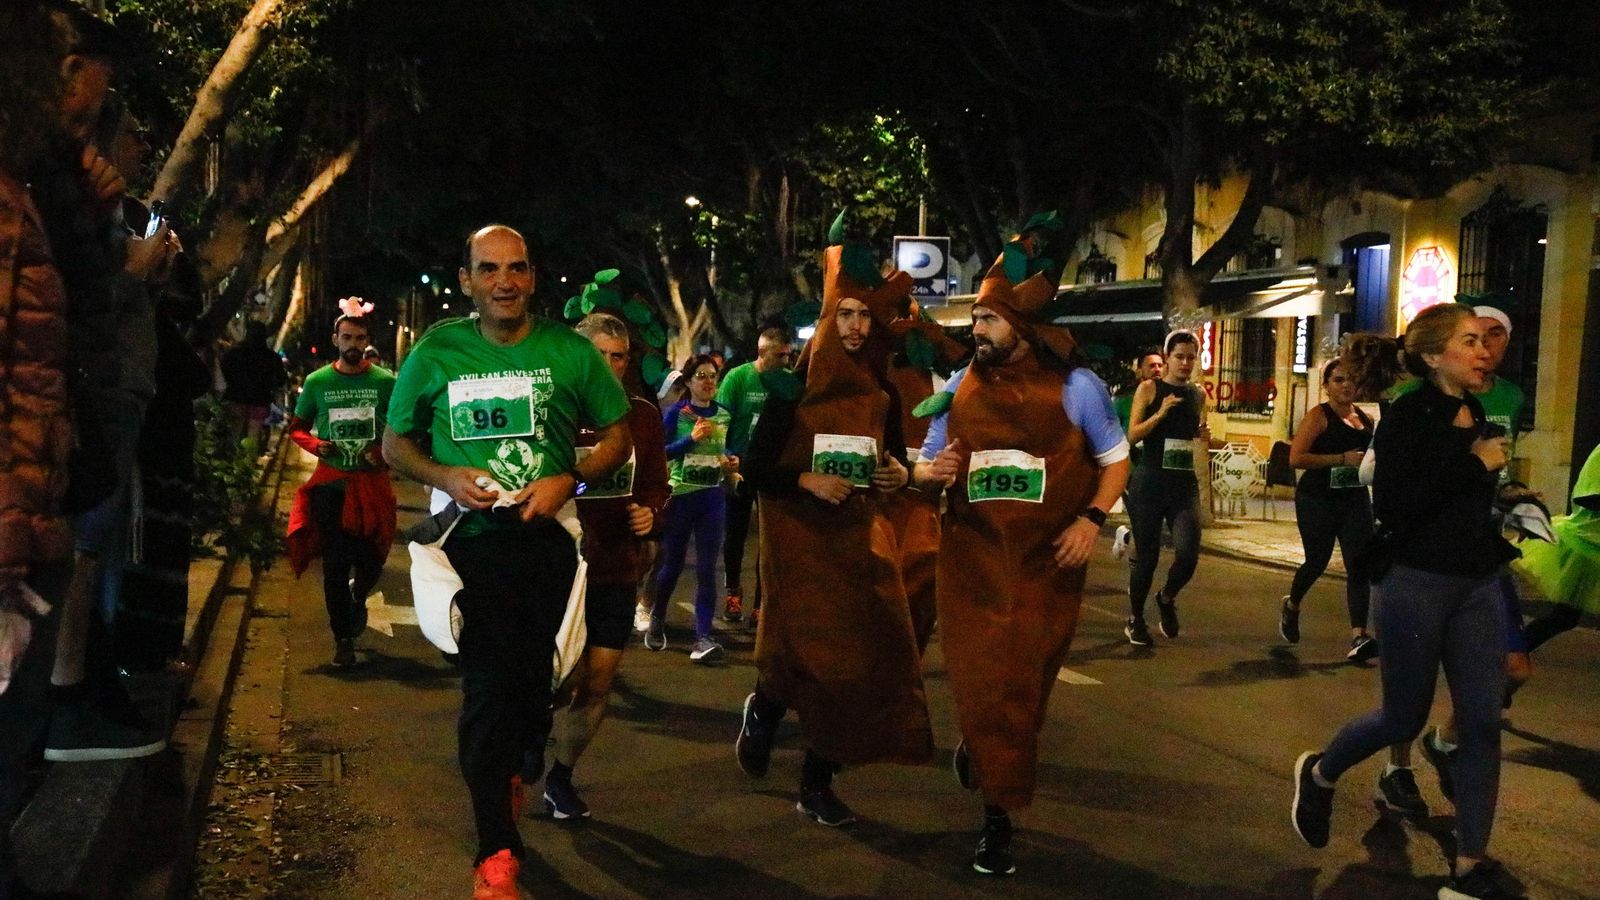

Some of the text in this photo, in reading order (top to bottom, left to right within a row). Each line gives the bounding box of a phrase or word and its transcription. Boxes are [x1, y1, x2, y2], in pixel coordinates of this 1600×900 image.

[912, 285, 929, 294] 24h
[481, 371, 500, 379] SAN
[502, 367, 551, 378] SILVESTRE
[531, 376, 553, 384] ERÍA
[473, 408, 509, 430] 96
[824, 460, 868, 479] 893
[977, 474, 1029, 493] 195
